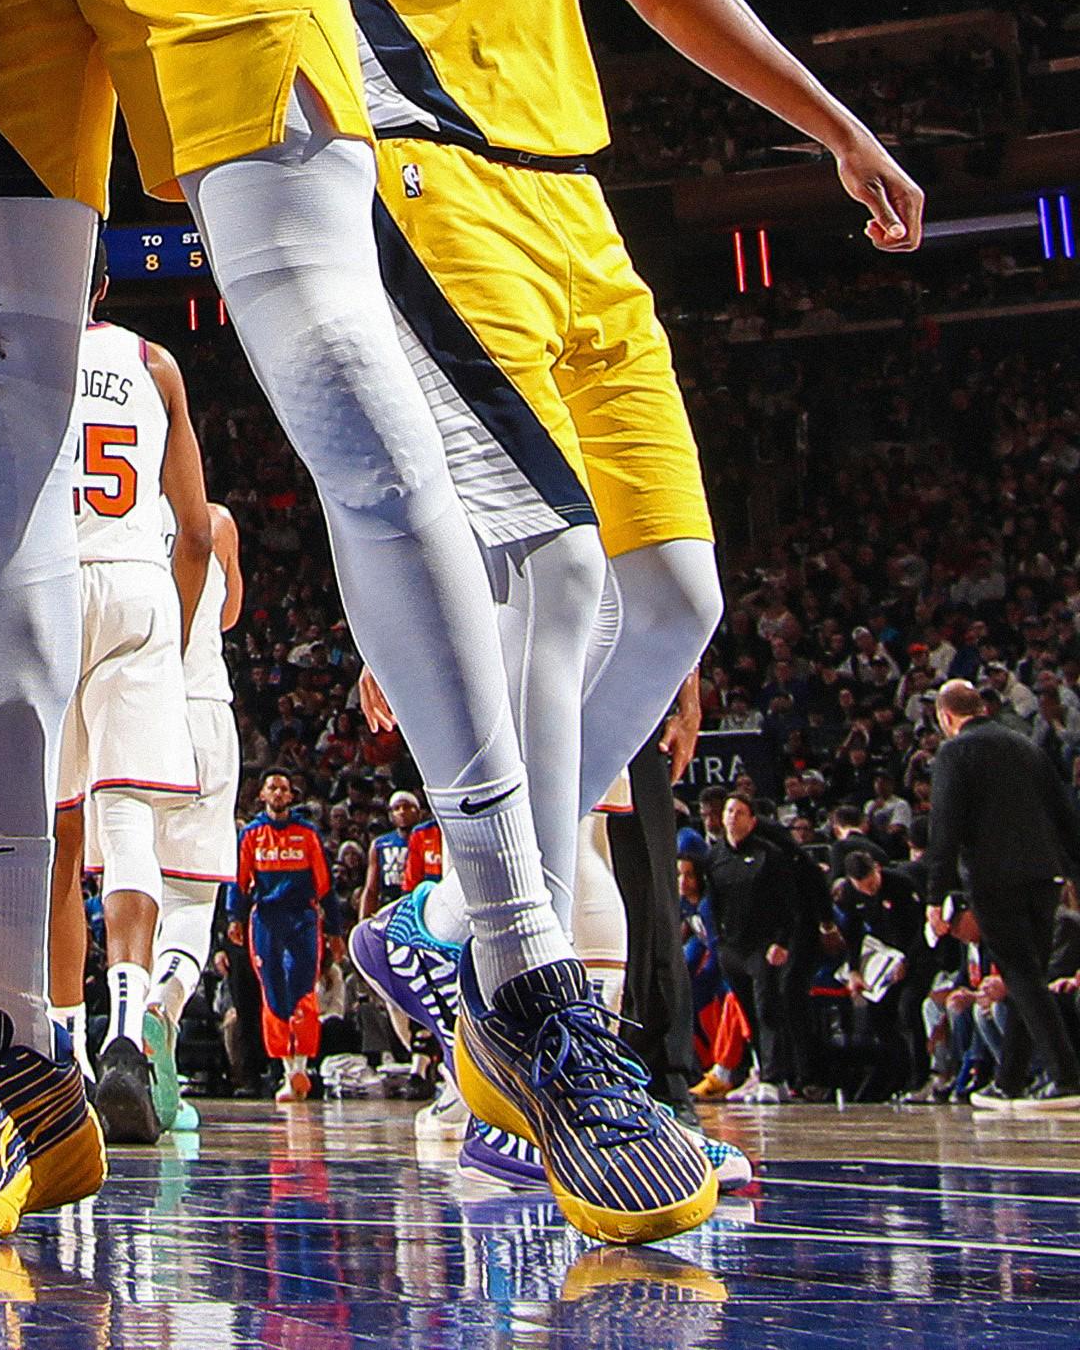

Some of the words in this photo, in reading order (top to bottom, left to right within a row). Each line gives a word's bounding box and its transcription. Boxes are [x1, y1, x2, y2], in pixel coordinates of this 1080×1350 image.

[141, 235, 163, 247] TO
[145, 254, 160, 271] 8
[189, 251, 203, 267] 5
[73, 422, 138, 519] 5
[671, 754, 743, 786] TRA
